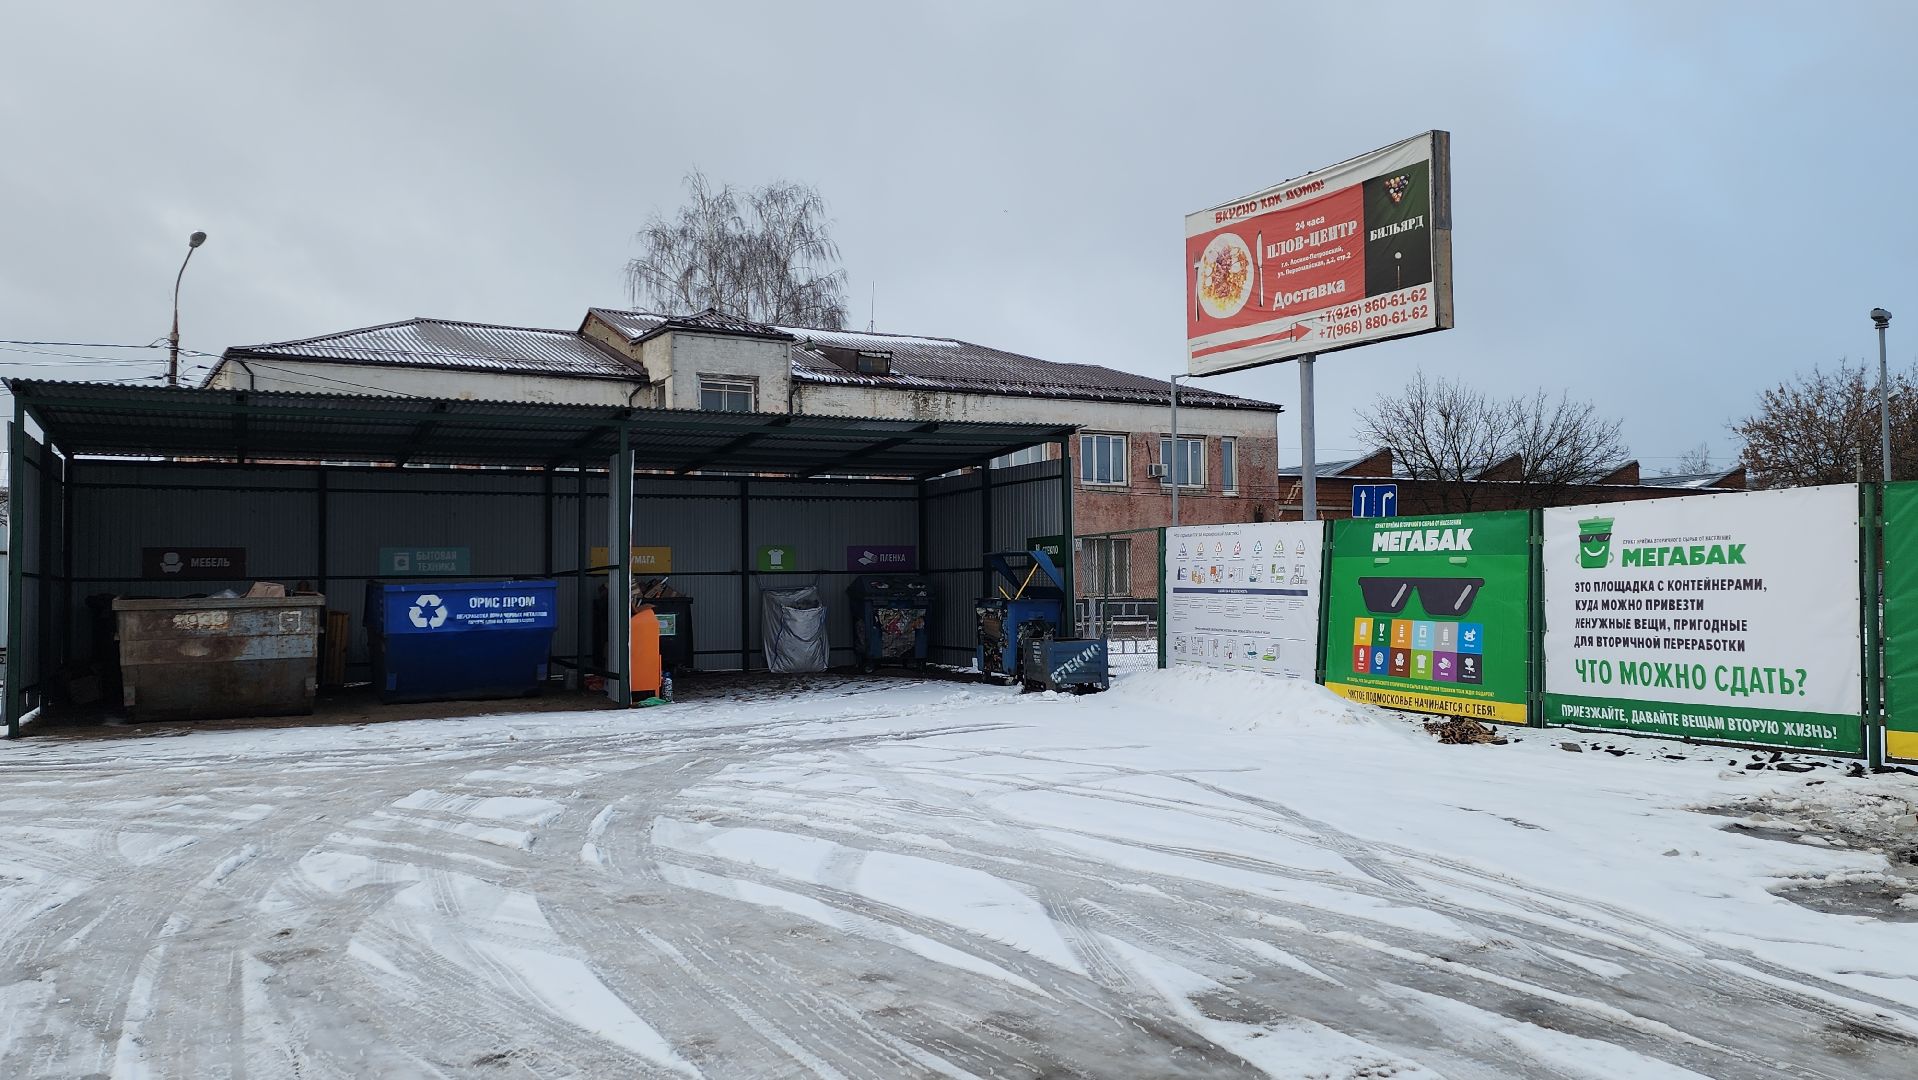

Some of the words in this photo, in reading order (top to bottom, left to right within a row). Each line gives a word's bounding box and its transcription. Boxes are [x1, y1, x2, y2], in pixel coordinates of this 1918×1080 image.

[1215, 200, 1258, 223] ВКУСНО
[1261, 193, 1282, 210] КАК
[1286, 179, 1325, 201] ДОМА!
[1295, 220, 1305, 232] 24
[1306, 216, 1325, 228] часа
[1369, 215, 1424, 241] БИЛЬЯРД
[1266, 220, 1357, 259] ПЛОВ-ЦЕНТР
[1272, 279, 1345, 311] Доставка
[1319, 303, 1362, 324] +7(926)
[1364, 287, 1427, 314] 860-61-62
[1319, 319, 1362, 340] +7(968)
[1365, 304, 1428, 330] 880-61-62
[1372, 528, 1473, 552] МЕГАБАК
[191, 557, 231, 568] МЕБЕЛЬ
[416, 551, 457, 561] БЫТОВАЯ
[416, 562, 457, 572] ТЕХНИКА
[631, 555, 656, 565] УМАГА
[879, 553, 906, 562] ПЛЕНКА
[1622, 543, 1746, 567] МЕГАБАК
[1574, 581, 1592, 593] ЭТО
[1593, 580, 1655, 594] ПЛОЩАДКА
[1657, 580, 1664, 592] С
[1667, 577, 1767, 593] КОНТЕЙНЕРАМИ,
[469, 597, 500, 609] ОРИС
[502, 596, 536, 608] ПРОМ
[1575, 599, 1599, 612] КУДА
[1601, 599, 1642, 611] МОЖНО
[1645, 599, 1704, 611] ПРИВЕЗТИ
[1575, 618, 1632, 630] НЕНУЖНЫЕ
[1634, 618, 1671, 633] ВЕЩИ,
[1673, 618, 1748, 633] ПРИГОДНЫЕ
[1573, 635, 1594, 649] ДЛЯ
[1596, 635, 1661, 650] ВТОРИЧНОЙ
[1663, 637, 1745, 652] ПЕРЕРАБОТКИ
[1050, 643, 1101, 684] СТЕКЛО
[1575, 659, 1612, 685] ЧТО
[1619, 660, 1707, 691] МОЖНО
[1714, 664, 1808, 697] СДАТЬ?
[1347, 689, 1366, 700] ЧИСТОЕ
[1366, 690, 1412, 706] ПОДМОСКОВЬЕ
[1414, 698, 1463, 713] НАЧИНАЕТСЯ
[1465, 704, 1470, 714] С
[1472, 704, 1496, 716] ТЕБЯ!
[1561, 703, 1629, 723] ПРИЕЗЖАЙТЕ,
[1631, 709, 1680, 727] ДАВАЙТЕ
[1681, 714, 1725, 732] ВЕЩАМ
[1728, 717, 1779, 735] ВТОРУЮ
[1782, 721, 1837, 740] ЖИЗНЬ!
